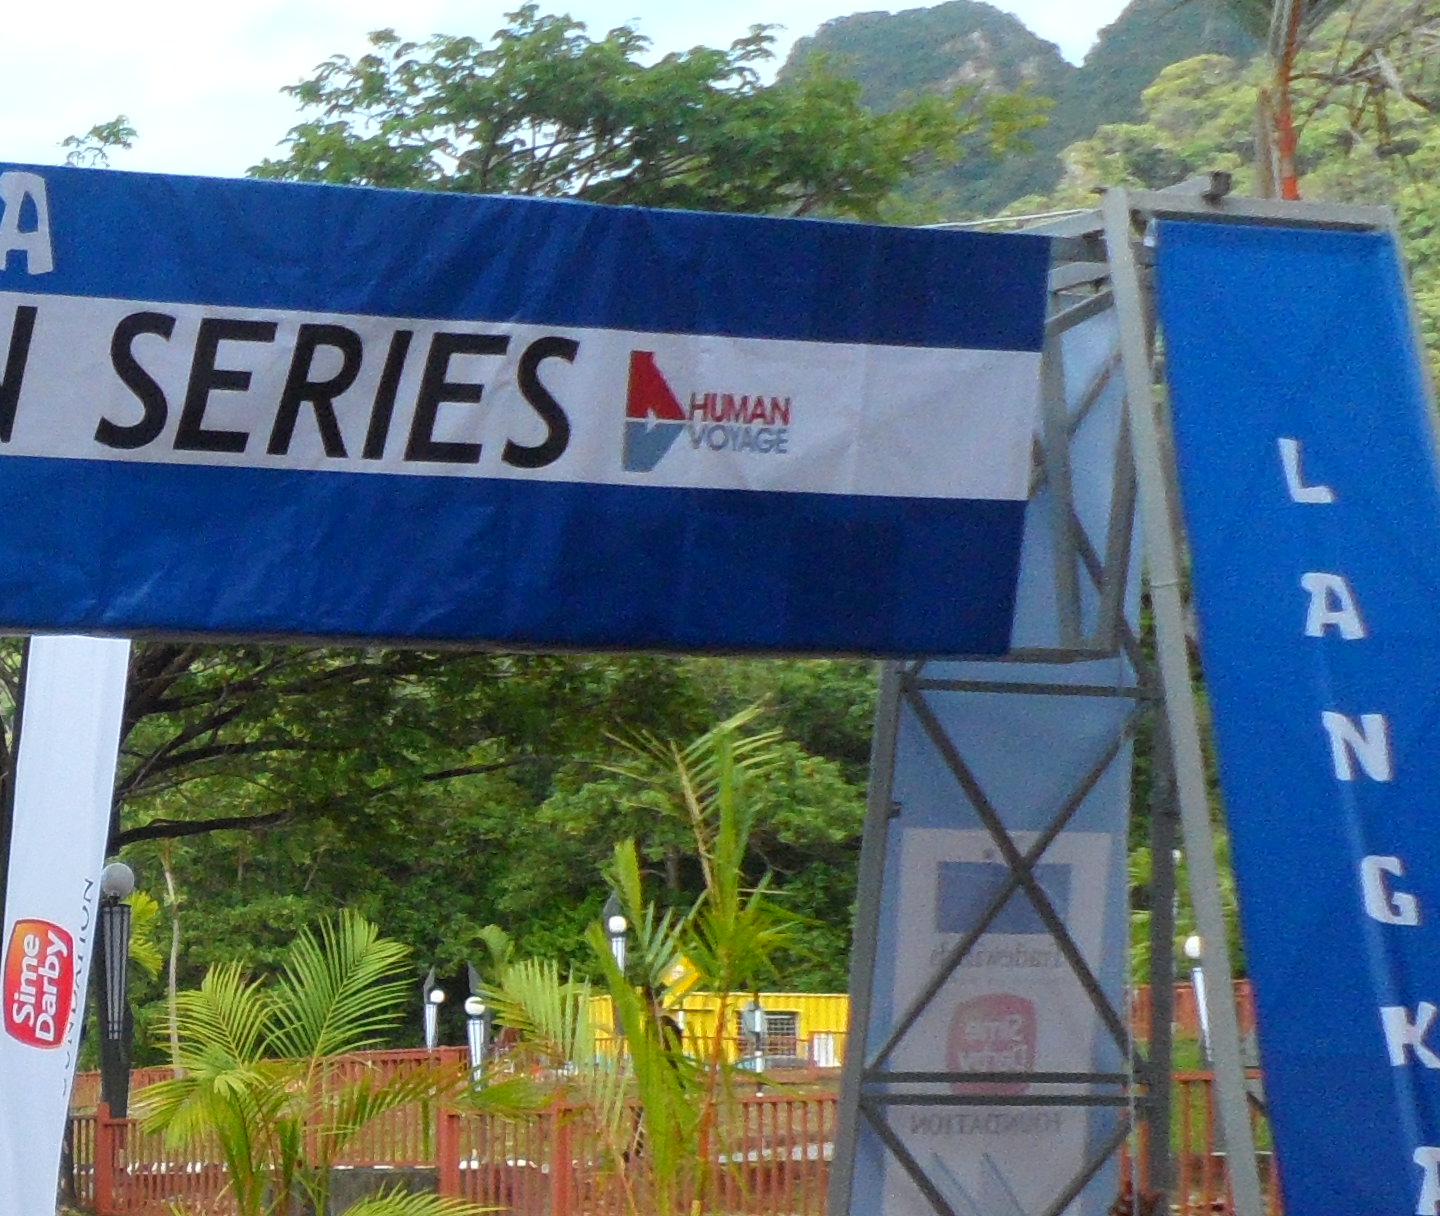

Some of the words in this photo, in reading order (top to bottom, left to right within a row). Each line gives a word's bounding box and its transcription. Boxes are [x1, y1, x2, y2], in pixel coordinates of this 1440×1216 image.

[94, 309, 581, 470] SERIES
[687, 391, 793, 426] HUMAN
[687, 423, 789, 455] VOYAGE
[12, 933, 41, 1028] Sime
[35, 929, 69, 1042] Darby
